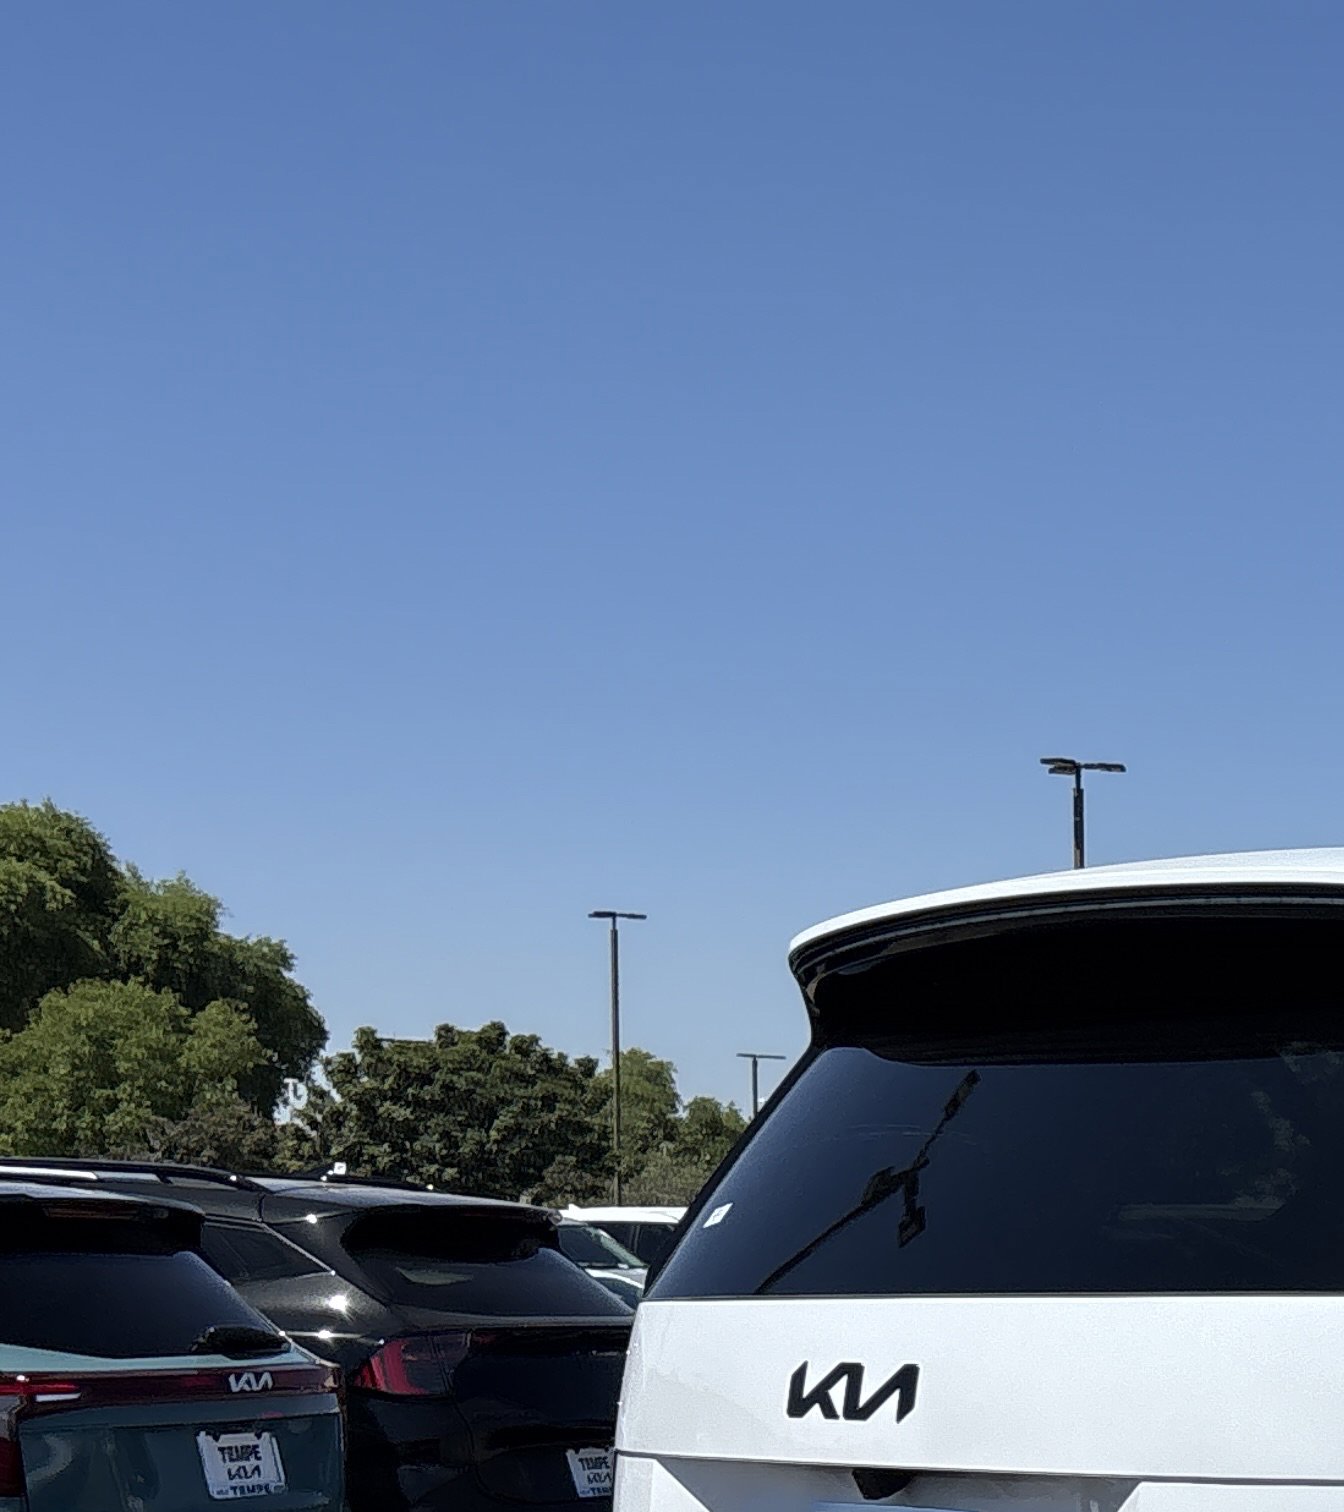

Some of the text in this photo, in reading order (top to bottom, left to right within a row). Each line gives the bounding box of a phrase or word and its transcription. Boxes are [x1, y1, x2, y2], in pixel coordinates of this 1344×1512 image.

[228, 1371, 274, 1393] KIA
[786, 1359, 920, 1424] KIA
[217, 1444, 262, 1463] TEMPE
[227, 1464, 262, 1480] KIA
